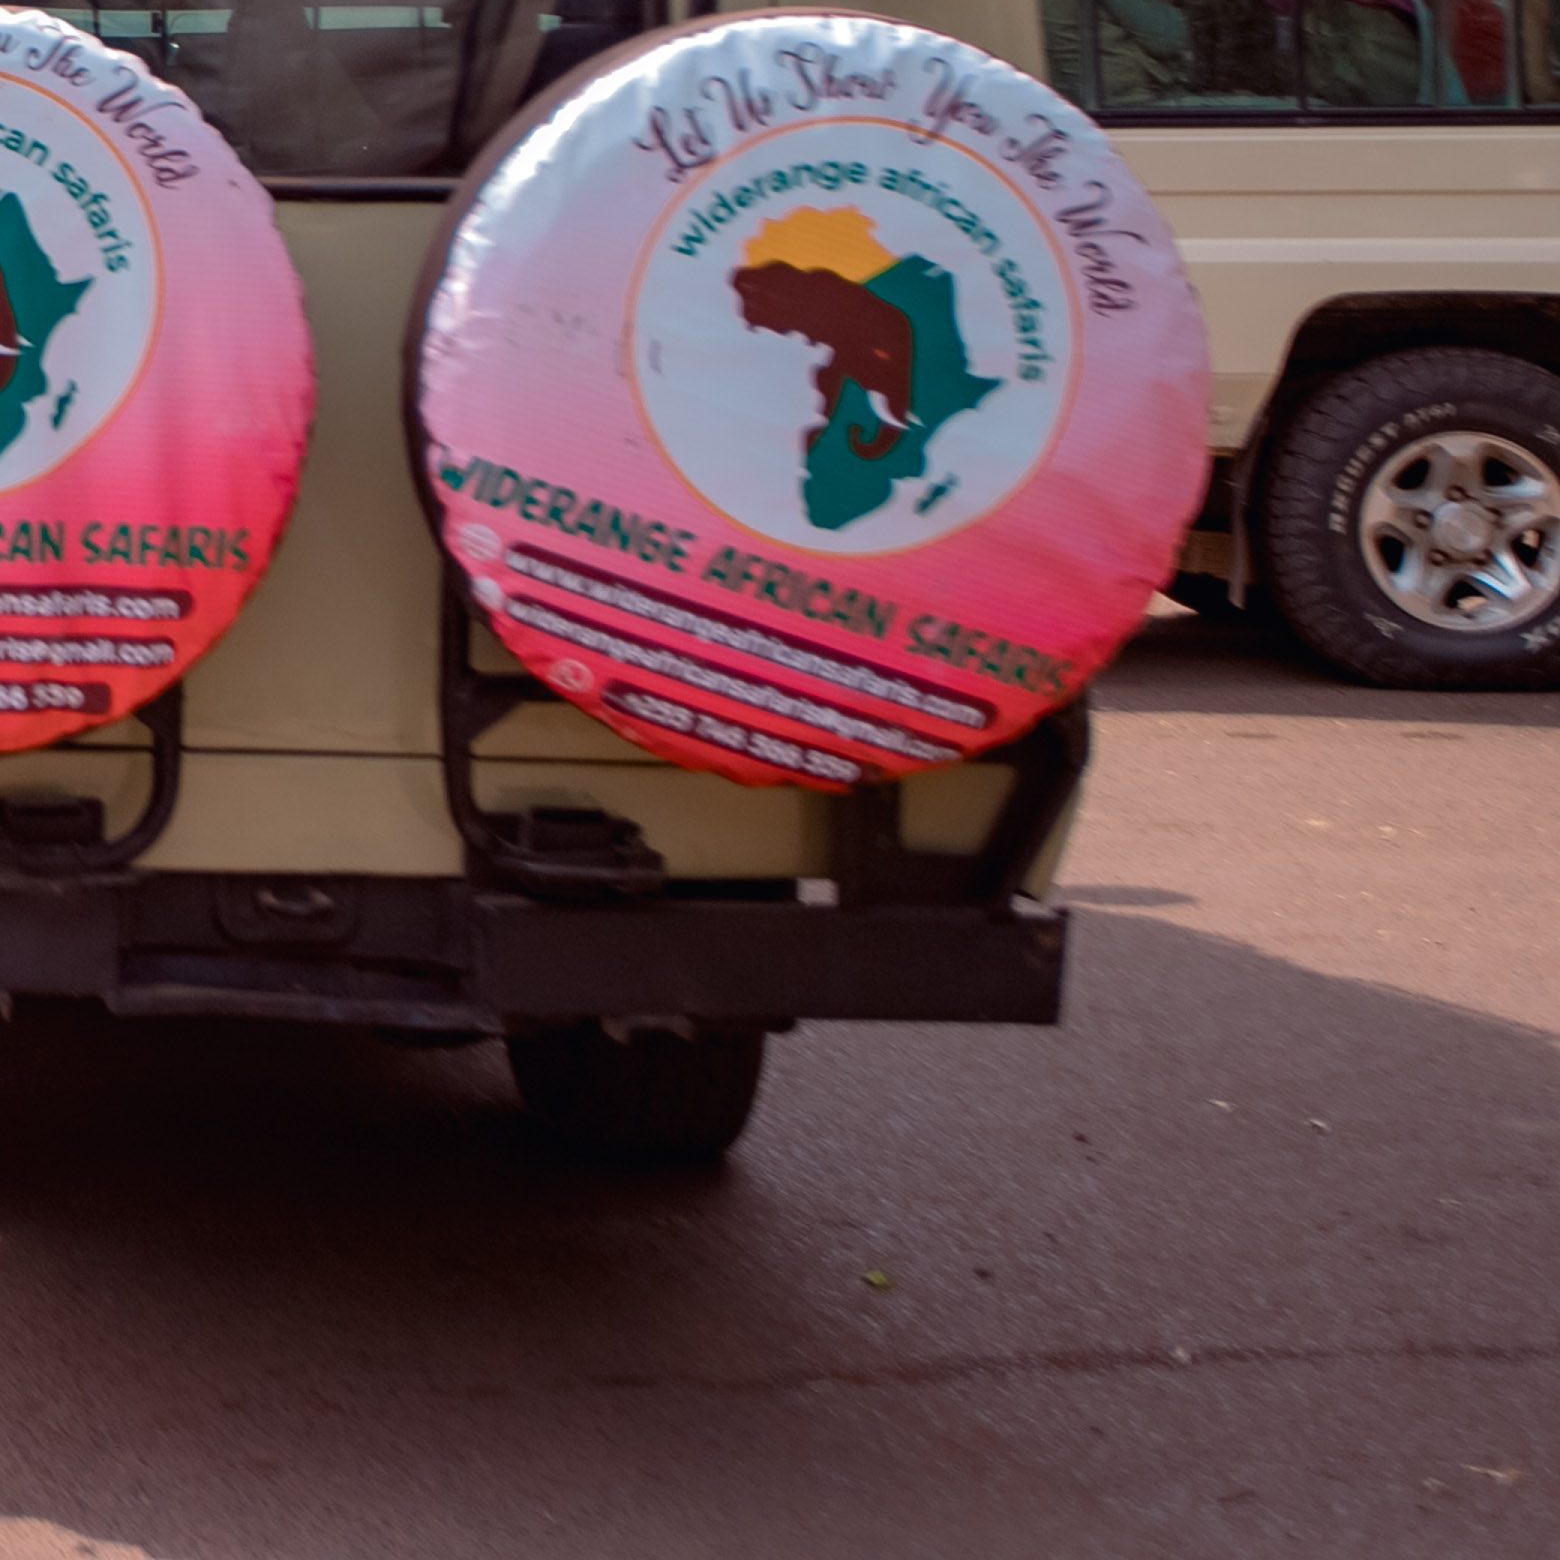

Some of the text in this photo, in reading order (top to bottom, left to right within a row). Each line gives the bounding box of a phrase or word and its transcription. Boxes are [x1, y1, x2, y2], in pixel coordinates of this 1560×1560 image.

[25, 25, 96, 87] The
[96, 65, 200, 190] World
[52, 160, 132, 273] safaris
[79, 521, 250, 571] SAFARIS
[436, 442, 1073, 693] WIDERANGE AFRICAN SAFARIS
